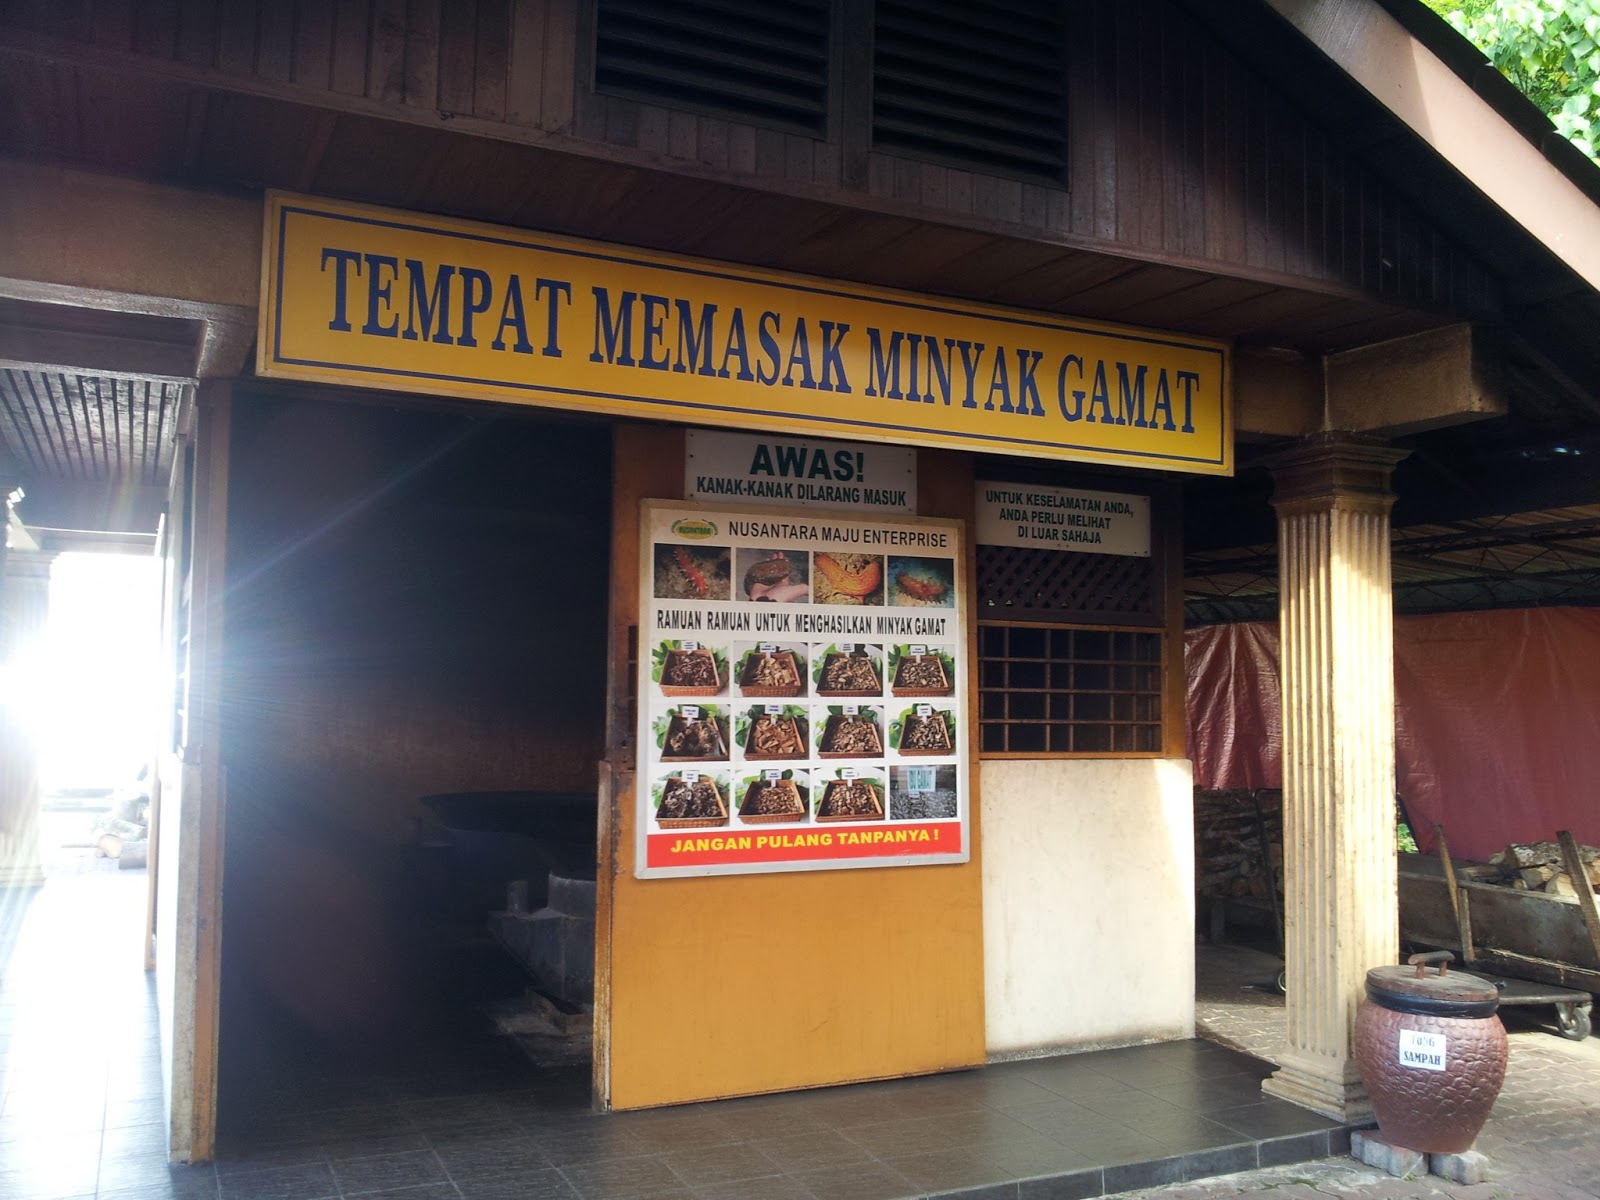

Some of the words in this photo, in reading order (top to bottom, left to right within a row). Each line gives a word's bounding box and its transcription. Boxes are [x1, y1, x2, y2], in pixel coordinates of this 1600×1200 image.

[321, 247, 571, 358] TEMPAT
[590, 286, 852, 395] MEMASAK
[864, 327, 1045, 417] MINYAK
[1057, 354, 1200, 434] GAMAT
[750, 444, 864, 482] AWAS!
[697, 476, 793, 499] KANAK-KANAK
[797, 483, 860, 504] DILARANG
[863, 488, 906, 506] MASUK
[985, 490, 1023, 504] UNTUK
[1027, 493, 1101, 512] KESELAMATAN
[1103, 501, 1134, 518] ANDA,
[999, 508, 1028, 522] ANDA
[1031, 511, 1064, 525] PERLU
[1067, 514, 1111, 529] MELIHAT
[728, 521, 818, 541] NUSANTARA
[822, 527, 860, 543] MAJU
[863, 529, 947, 548] ENTERPRISE
[1018, 526, 1028, 538] DI
[1031, 527, 1059, 541] LUAR
[1062, 529, 1102, 544] SAHAJA
[657, 610, 701, 630] RAMUAN
[707, 611, 750, 632] RAMUAN
[756, 613, 790, 633] UNTUK
[795, 614, 872, 634] MENGHASILKAN
[877, 616, 913, 635] MINYAK
[914, 618, 946, 636] GAMAT
[671, 836, 752, 854] JANGAN
[757, 833, 833, 849] PULANG
[837, 829, 931, 845] TANPANYA
[1404, 1051, 1441, 1065] SAMPAH
